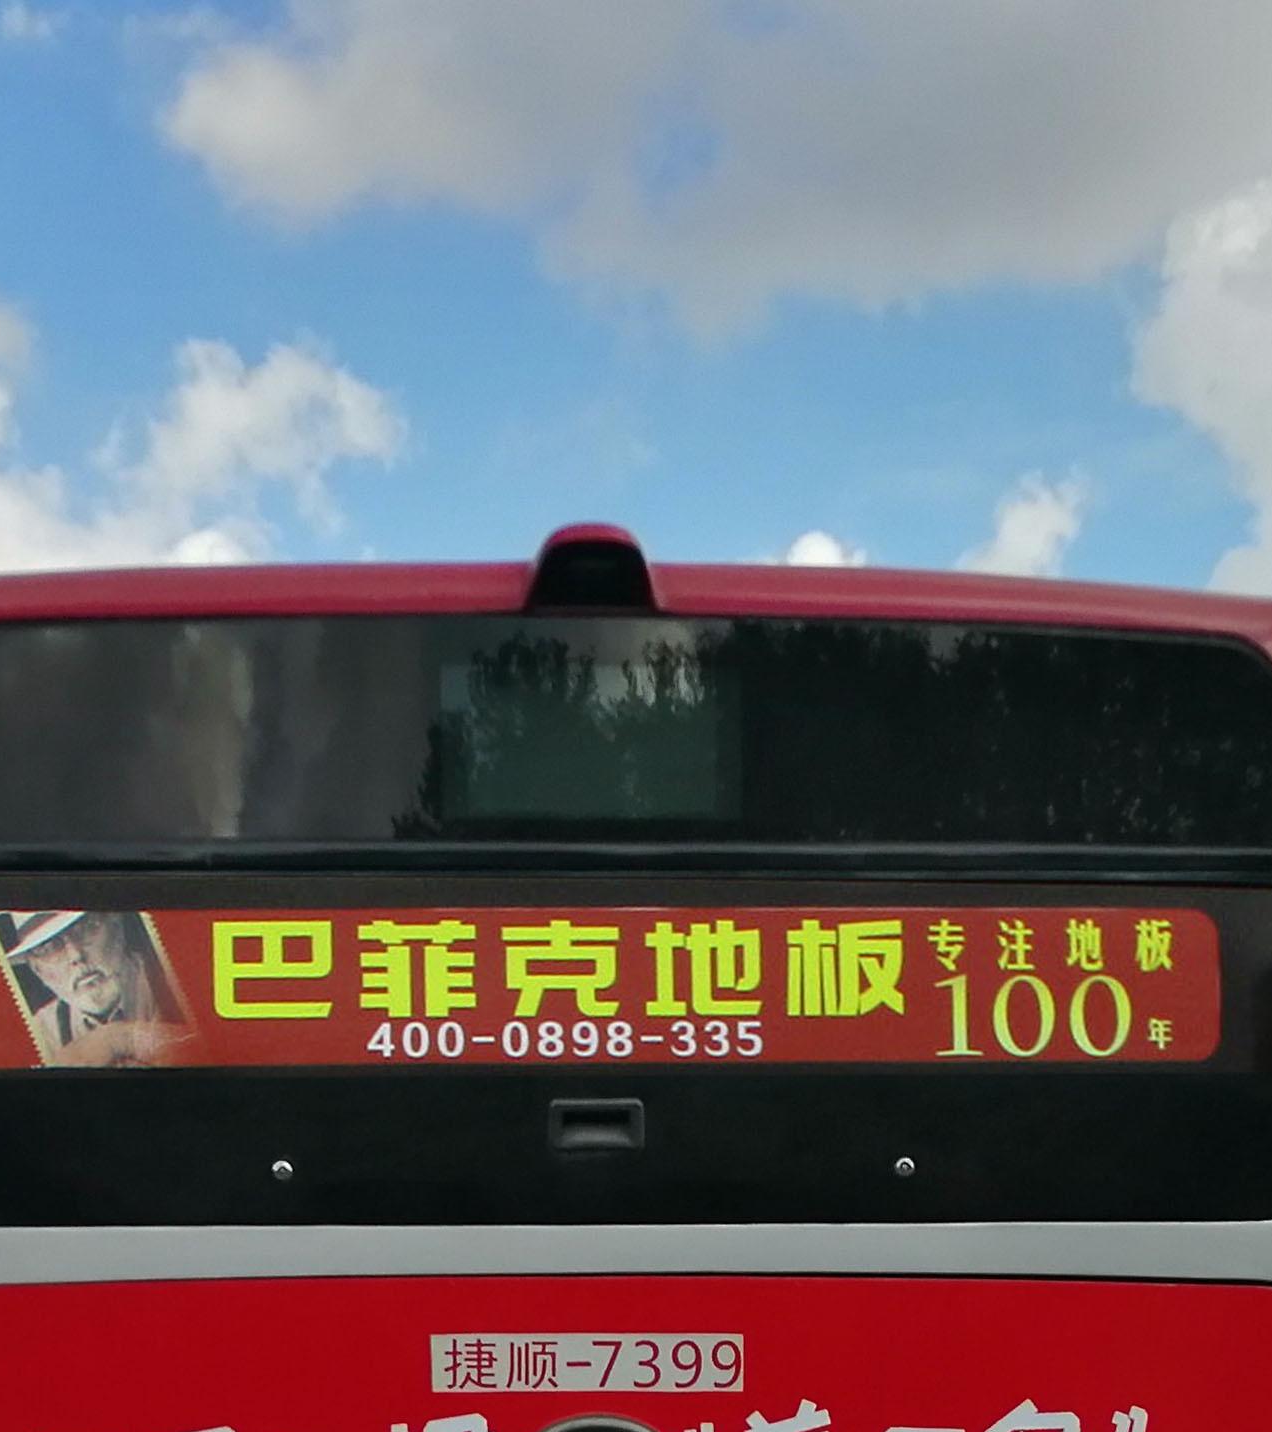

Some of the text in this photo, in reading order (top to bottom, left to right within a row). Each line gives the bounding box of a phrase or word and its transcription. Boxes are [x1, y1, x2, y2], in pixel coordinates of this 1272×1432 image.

[211, 918, 905, 1019] 巴菲克地板
[926, 918, 1174, 972] 专注地板
[366, 1019, 765, 1059] 400-0898-335
[443, 1337, 744, 1390] 捷顺-7399
